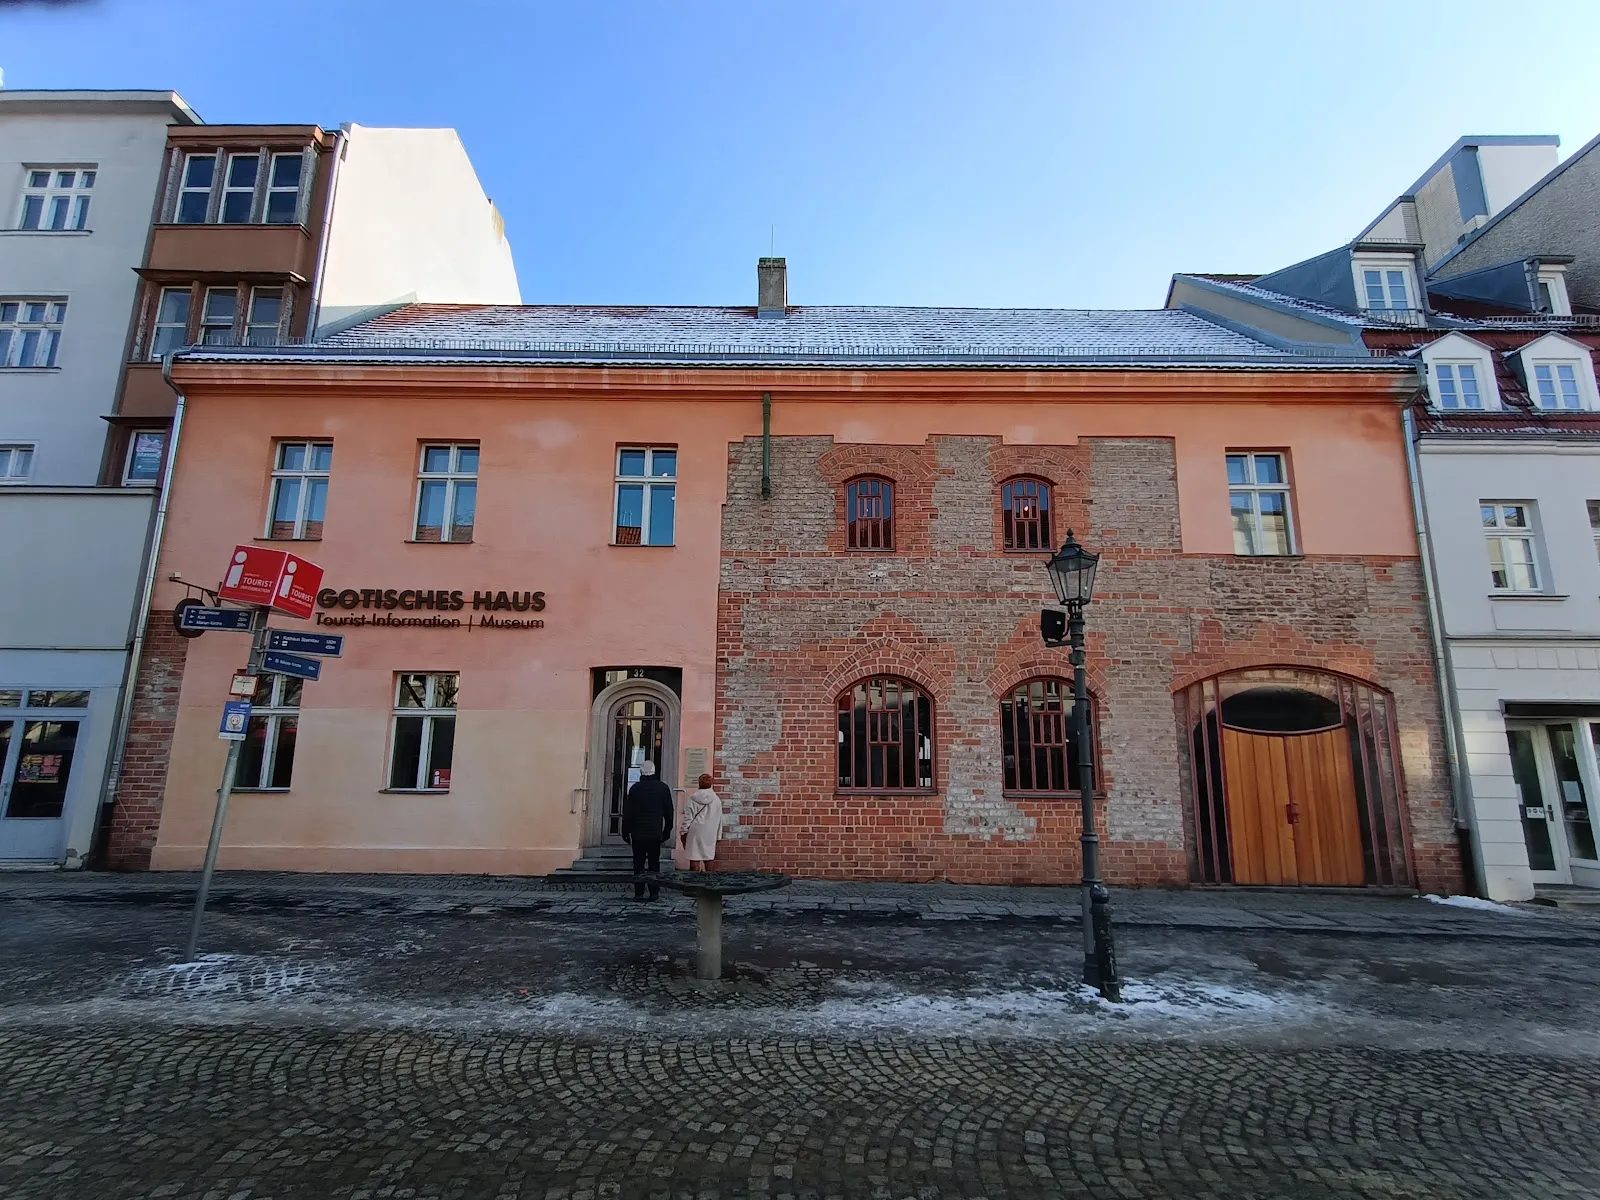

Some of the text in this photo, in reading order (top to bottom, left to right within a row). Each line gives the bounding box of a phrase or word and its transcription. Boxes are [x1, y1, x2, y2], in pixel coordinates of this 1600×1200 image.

[243, 577, 273, 588] TOURIST
[291, 589, 314, 603] TOURIST
[316, 588, 464, 611] GOTISCHES
[473, 590, 546, 612] HAUS
[289, 597, 311, 608] INFORMATION
[315, 612, 461, 628] Tourist-Information
[479, 615, 545, 629] Museum
[633, 669, 645, 678] 32
